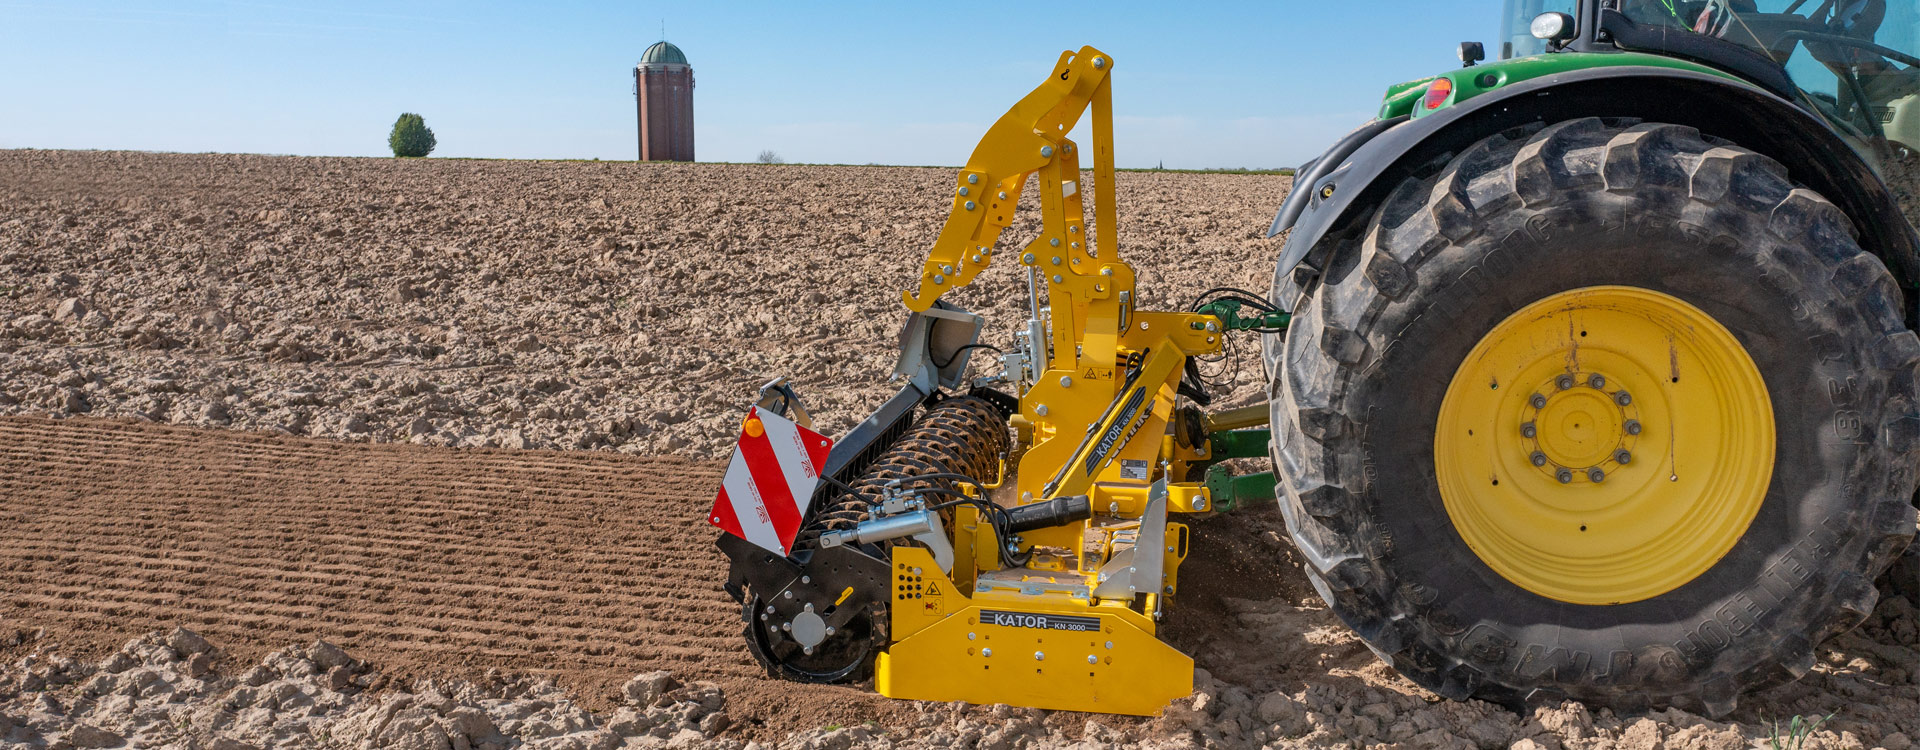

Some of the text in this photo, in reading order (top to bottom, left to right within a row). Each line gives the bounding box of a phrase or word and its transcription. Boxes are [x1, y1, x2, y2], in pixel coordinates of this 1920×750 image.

[1096, 424, 1123, 458] KATOR
[1656, 514, 1857, 677] TRELLEBORG
[994, 613, 1086, 631] KATOR KN 3000
